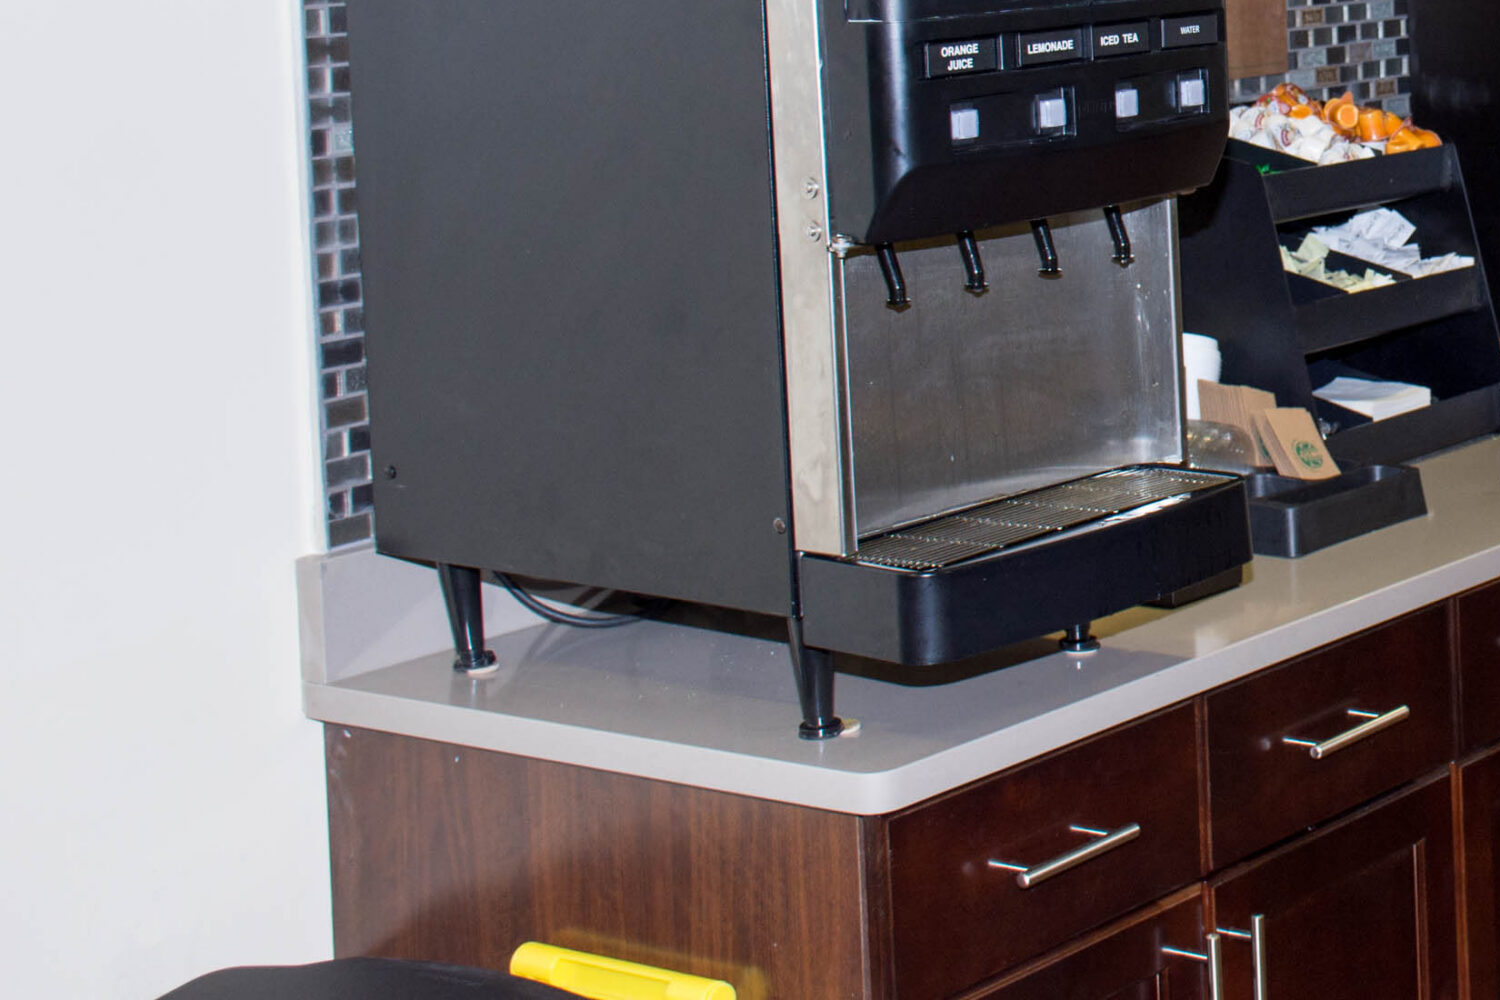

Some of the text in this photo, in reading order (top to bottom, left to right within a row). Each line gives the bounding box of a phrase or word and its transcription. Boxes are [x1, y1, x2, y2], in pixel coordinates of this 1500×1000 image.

[1180, 25, 1200, 35] WATER
[1027, 39, 1075, 55] LEMONADE
[1100, 32, 1139, 47] ICED TEA
[940, 43, 979, 58] ORANGE
[947, 58, 974, 71] JUICE
